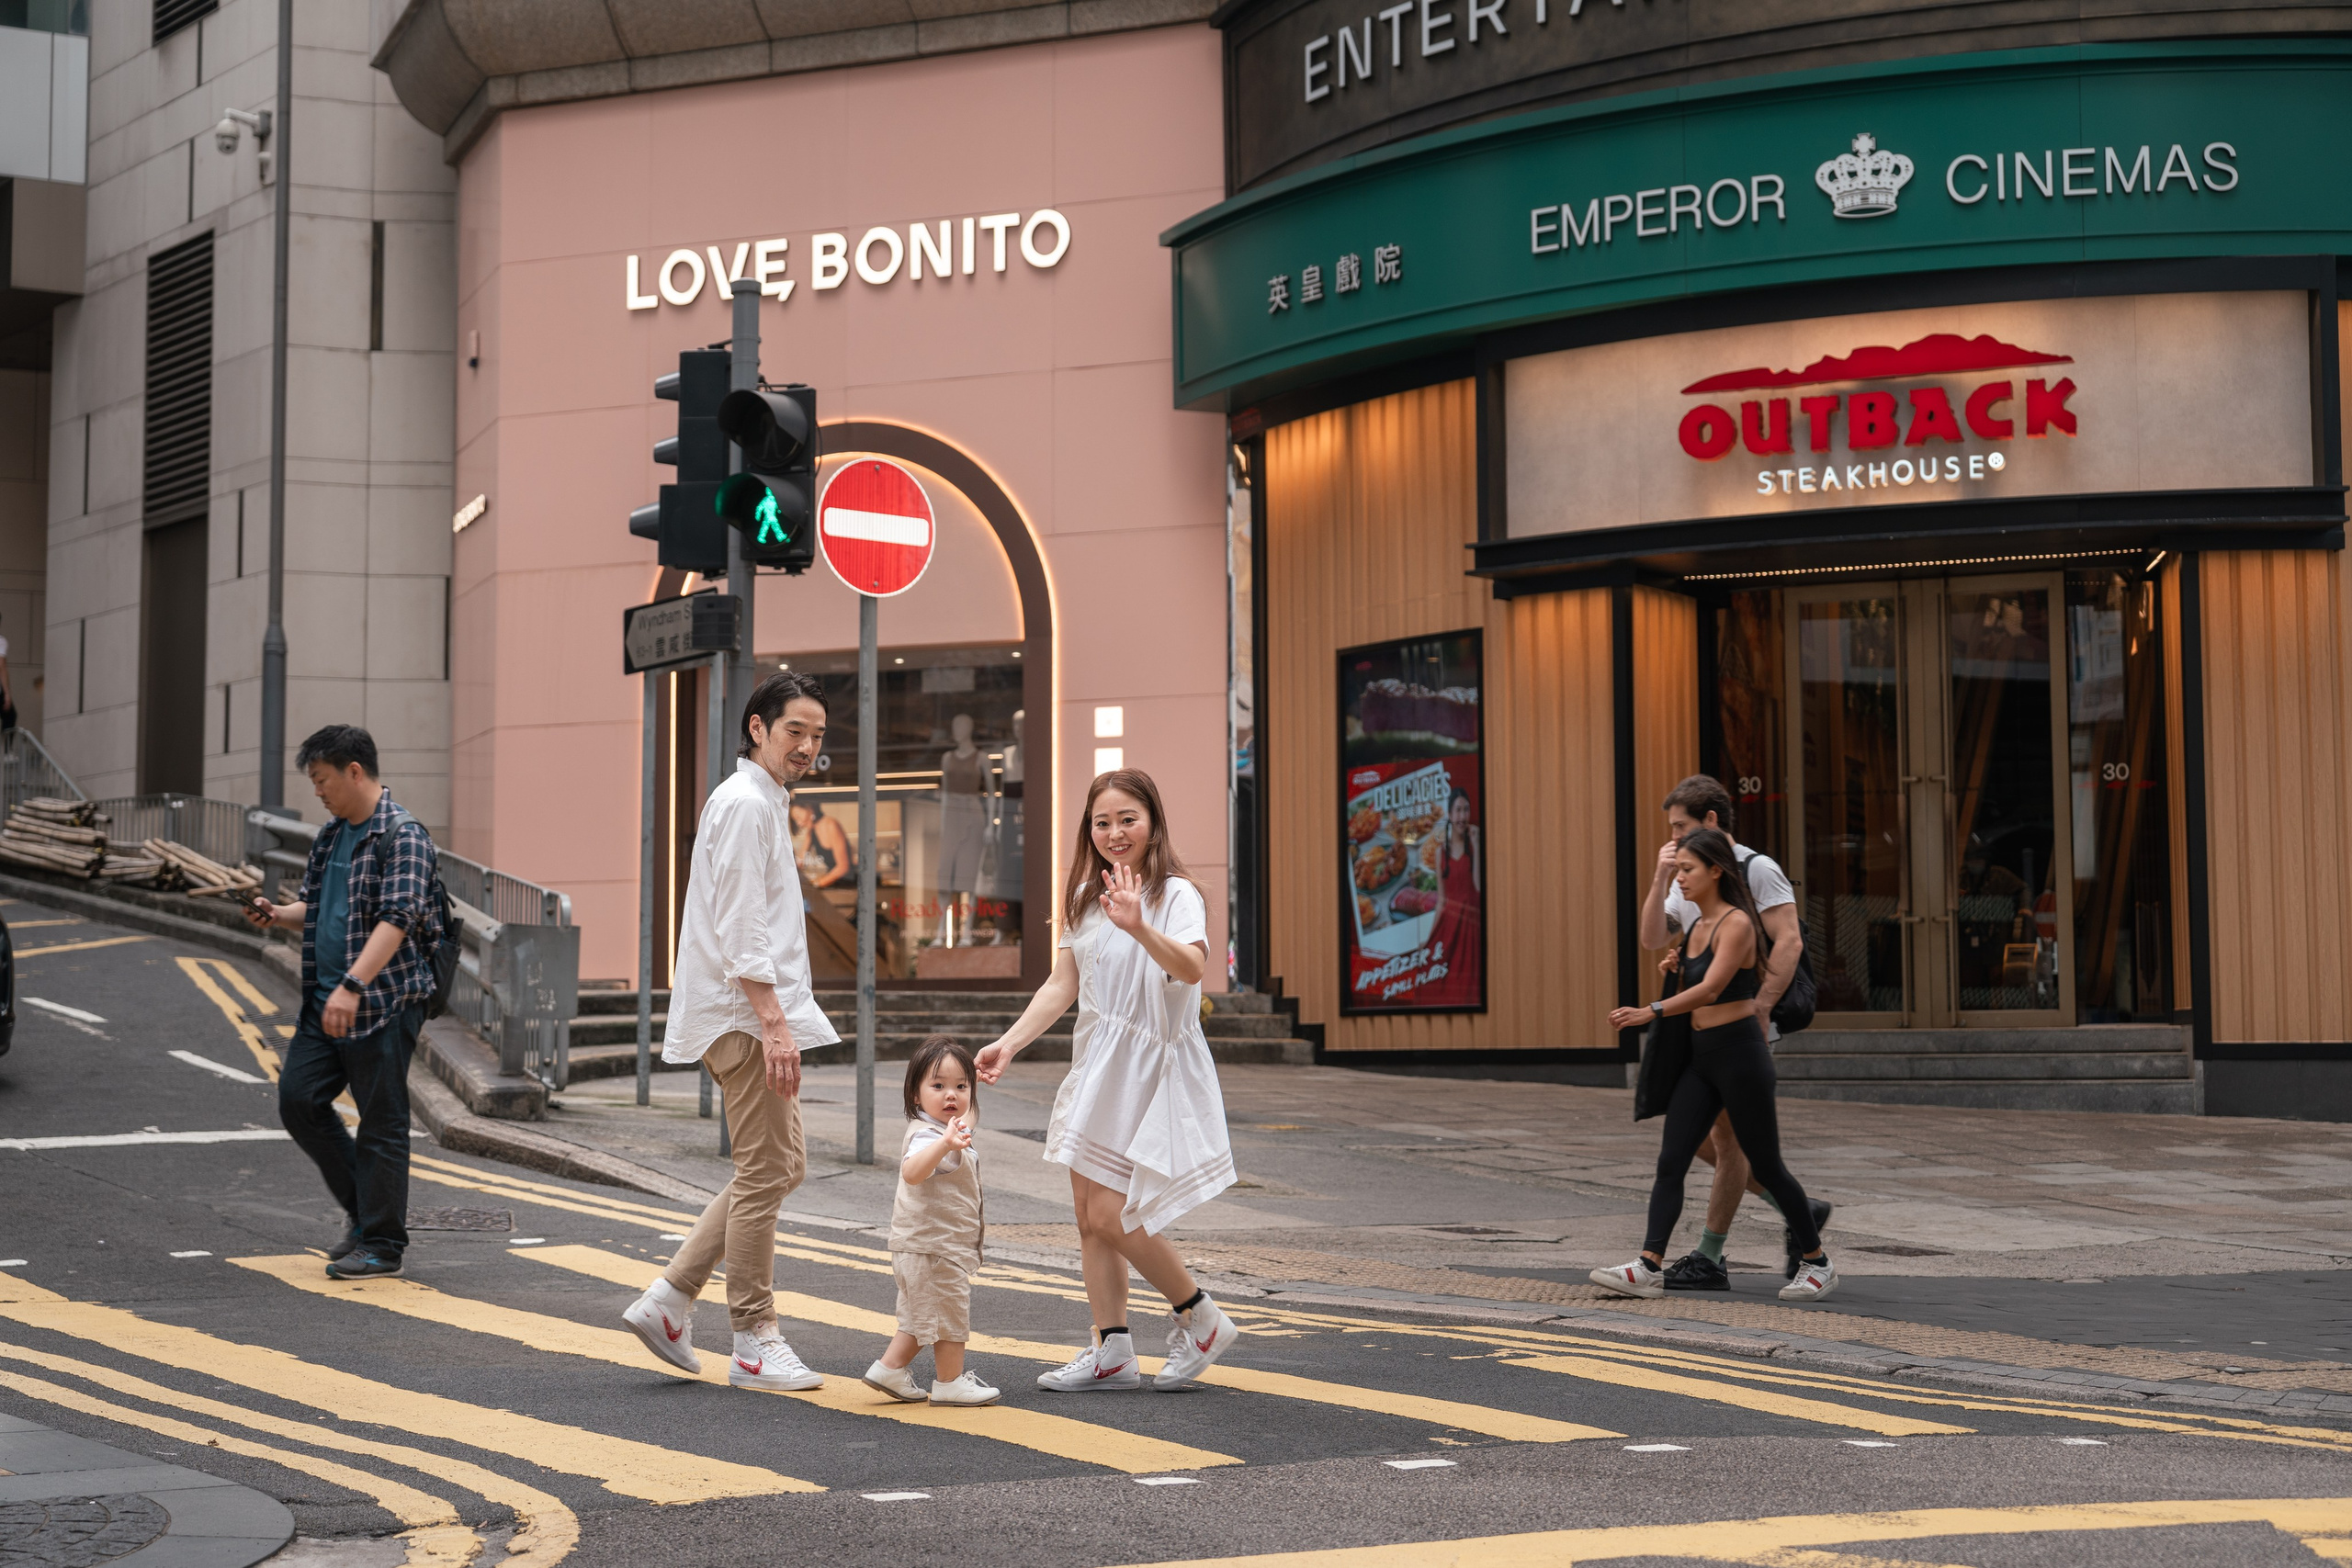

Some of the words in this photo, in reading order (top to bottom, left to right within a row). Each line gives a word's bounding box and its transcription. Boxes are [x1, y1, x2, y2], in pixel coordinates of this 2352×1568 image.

[1304, 0, 1624, 104] ENTER
[1531, 174, 1786, 255] EMPEROR
[1945, 141, 2240, 205] CINEMAS
[811, 209, 1071, 290] BONITO
[1267, 243, 1401, 315] 英皇戲院
[1679, 377, 2078, 461] OUTBACK
[684, 604, 692, 620] S
[1374, 772, 1452, 812] DELICACIES
[1738, 775, 1762, 795] 30
[2102, 762, 2130, 781] 30
